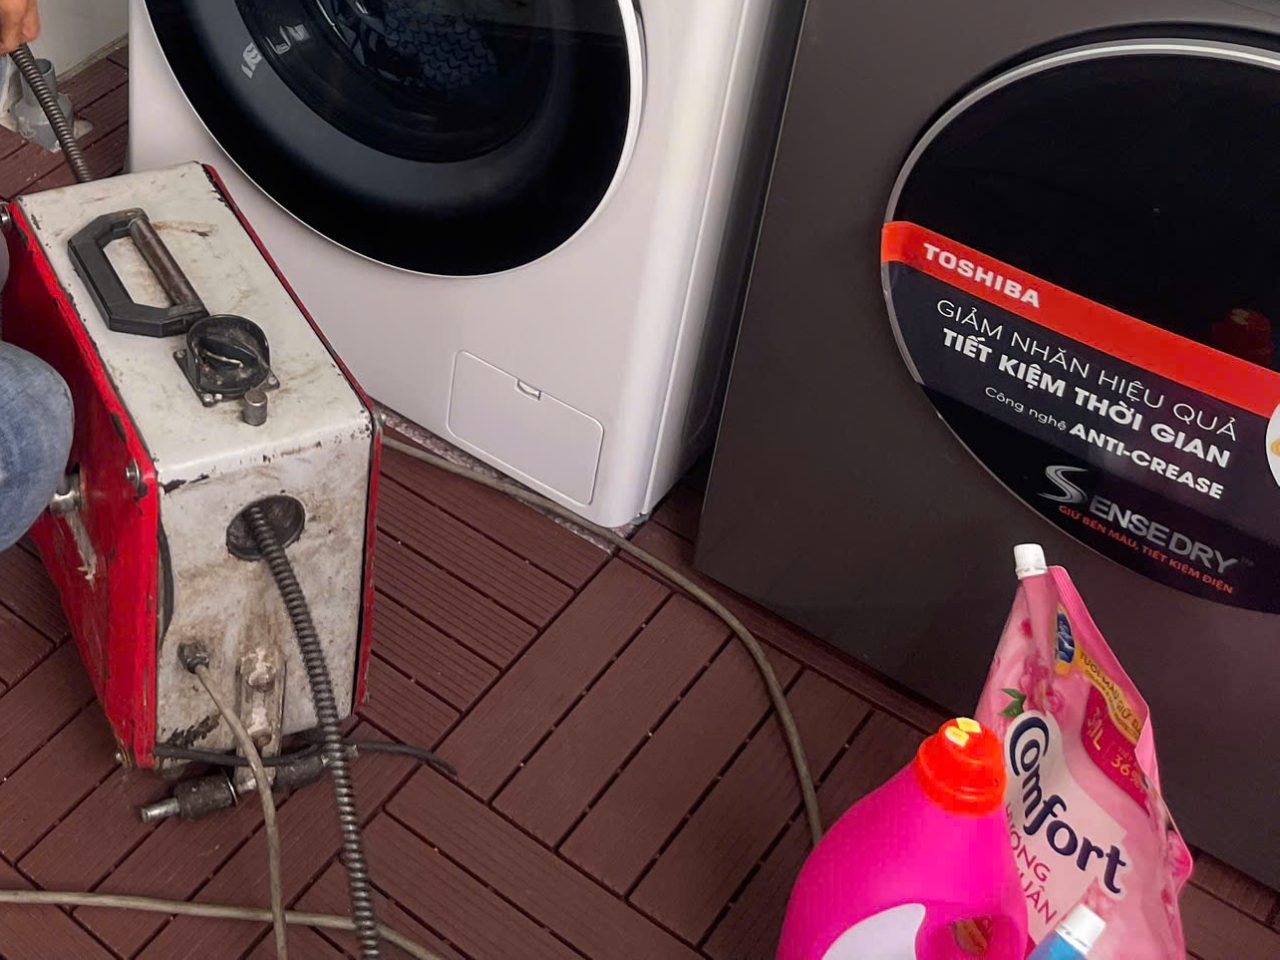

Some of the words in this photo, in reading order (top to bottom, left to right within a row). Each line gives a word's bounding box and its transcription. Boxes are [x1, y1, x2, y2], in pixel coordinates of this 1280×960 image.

[923, 242, 1040, 309] TOSHIBA
[937, 299, 1003, 340] GIẢM
[1010, 331, 1090, 379] NHĂN
[1097, 369, 1165, 409] HIỆU
[1172, 402, 1237, 442] QUẢ
[943, 327, 993, 363] TIẾT
[998, 353, 1067, 397] KIỆM
[1074, 386, 1143, 431] THỜI
[1150, 422, 1231, 468] GIAN
[985, 386, 1024, 413] Công
[1028, 408, 1067, 431] nghệ
[1069, 422, 1224, 500] ANTI-CREASE
[1202, 573, 1234, 595] ĐIỆN
[1009, 716, 1127, 894] Comfort
